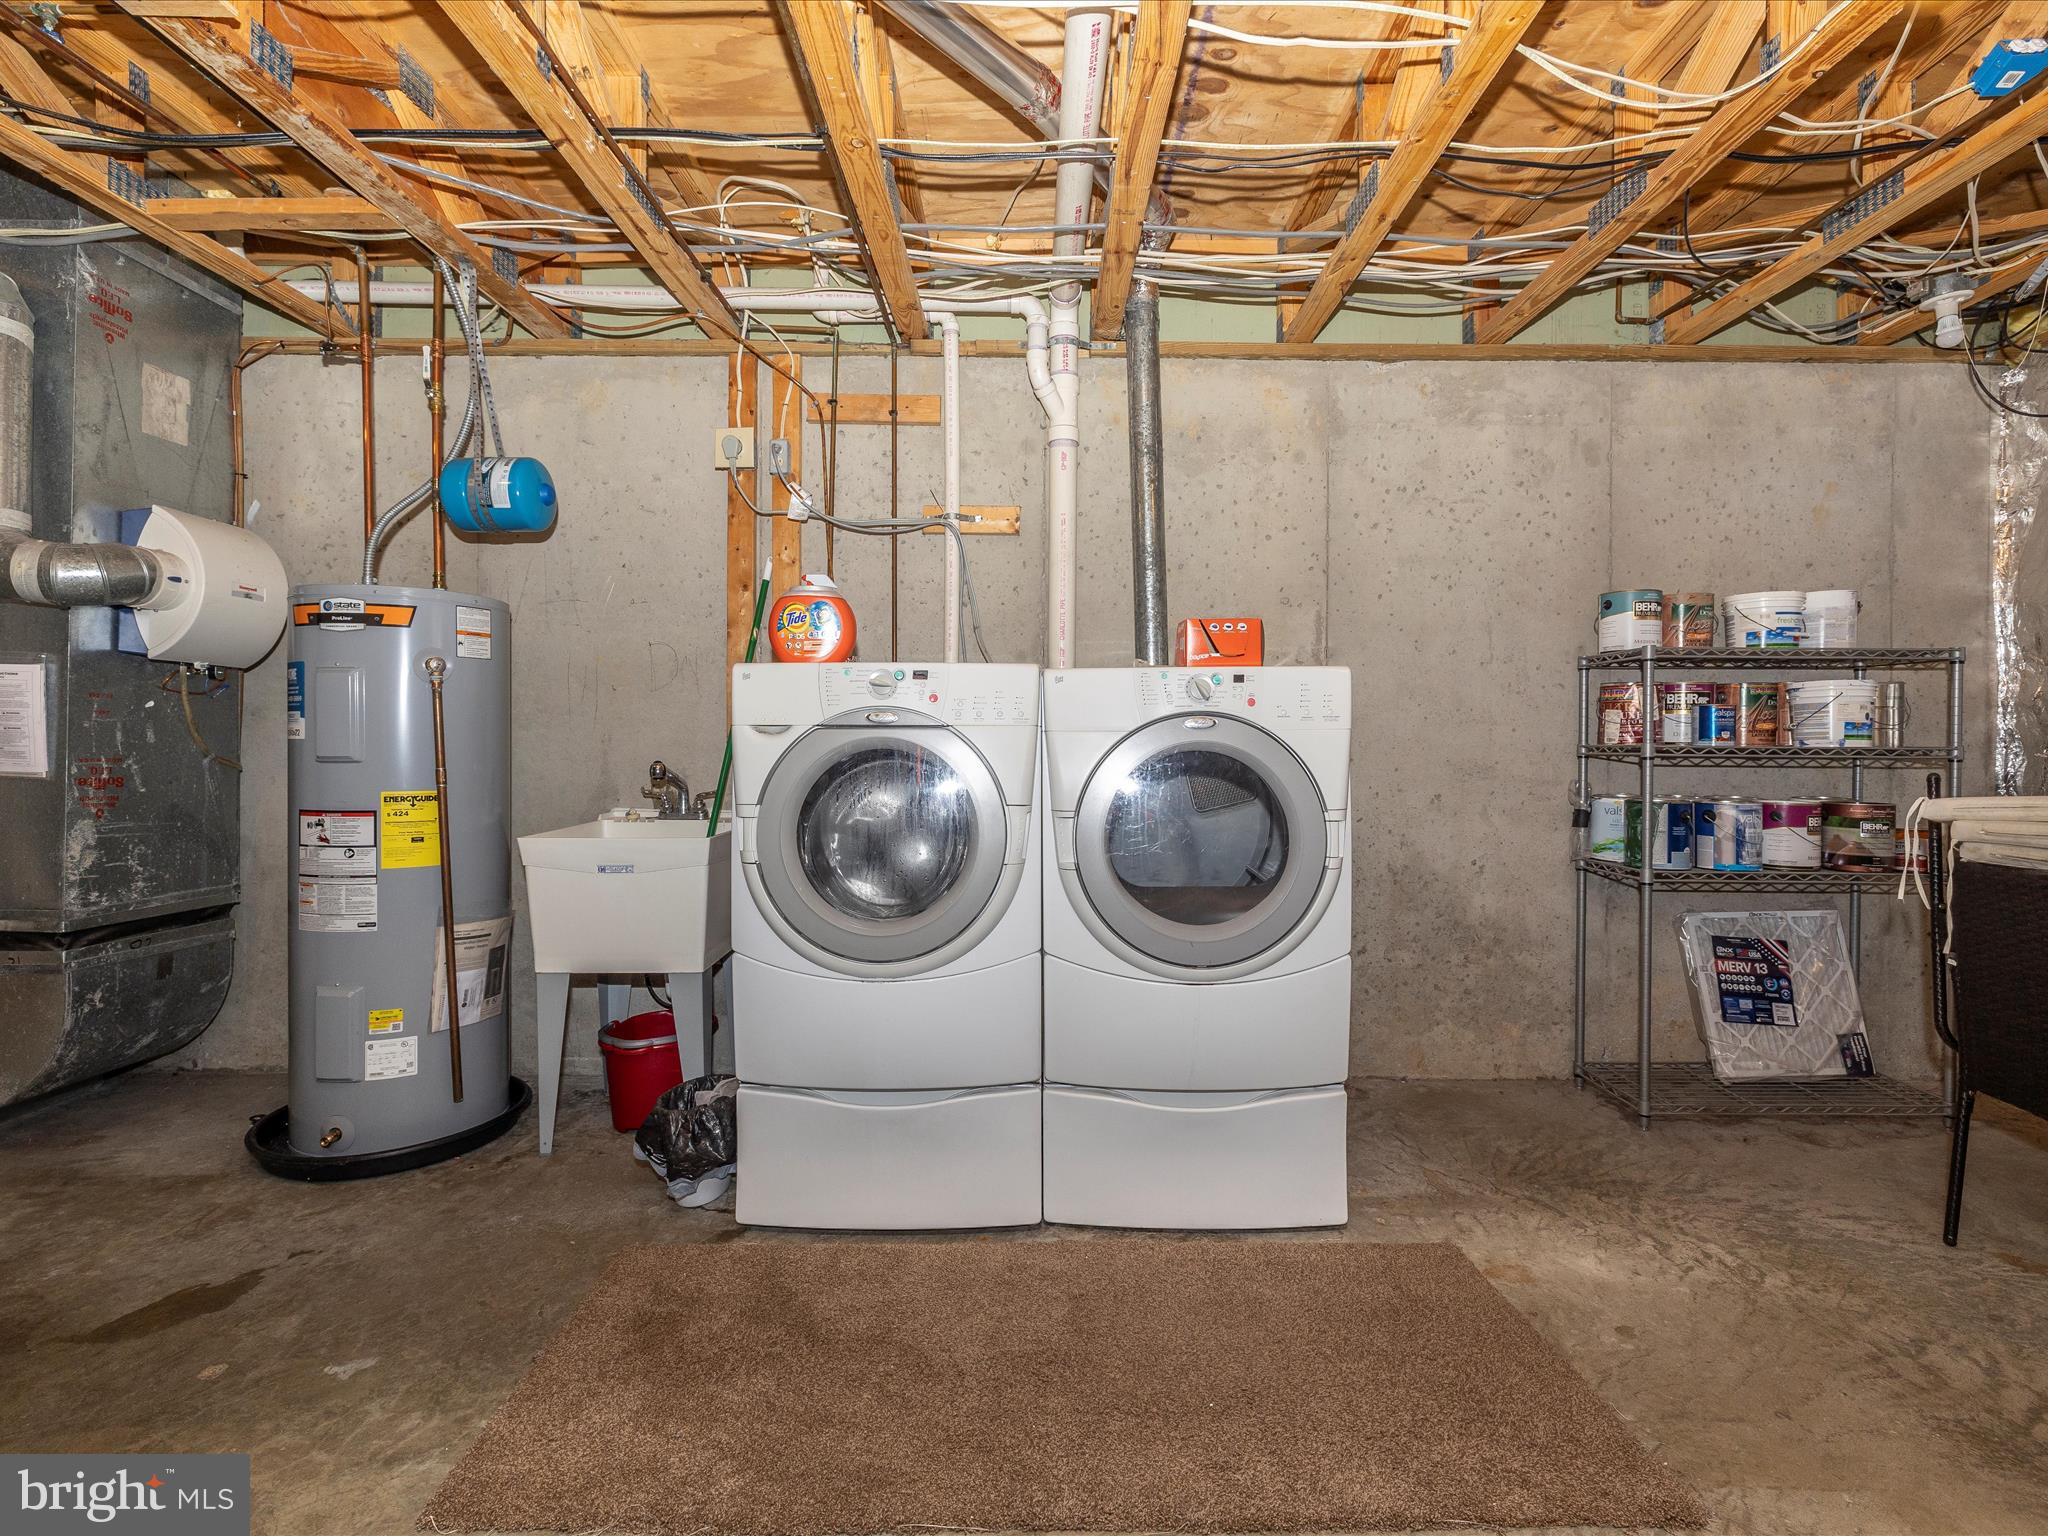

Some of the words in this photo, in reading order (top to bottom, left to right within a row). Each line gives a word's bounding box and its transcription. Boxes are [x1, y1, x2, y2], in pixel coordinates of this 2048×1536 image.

[333, 601, 361, 609] state
[1636, 602, 1658, 611] BEHR
[786, 612, 807, 627] Tide
[1667, 694, 1699, 704] BEHR
[1718, 960, 1751, 974] MERV
[1754, 963, 1768, 974] 13
